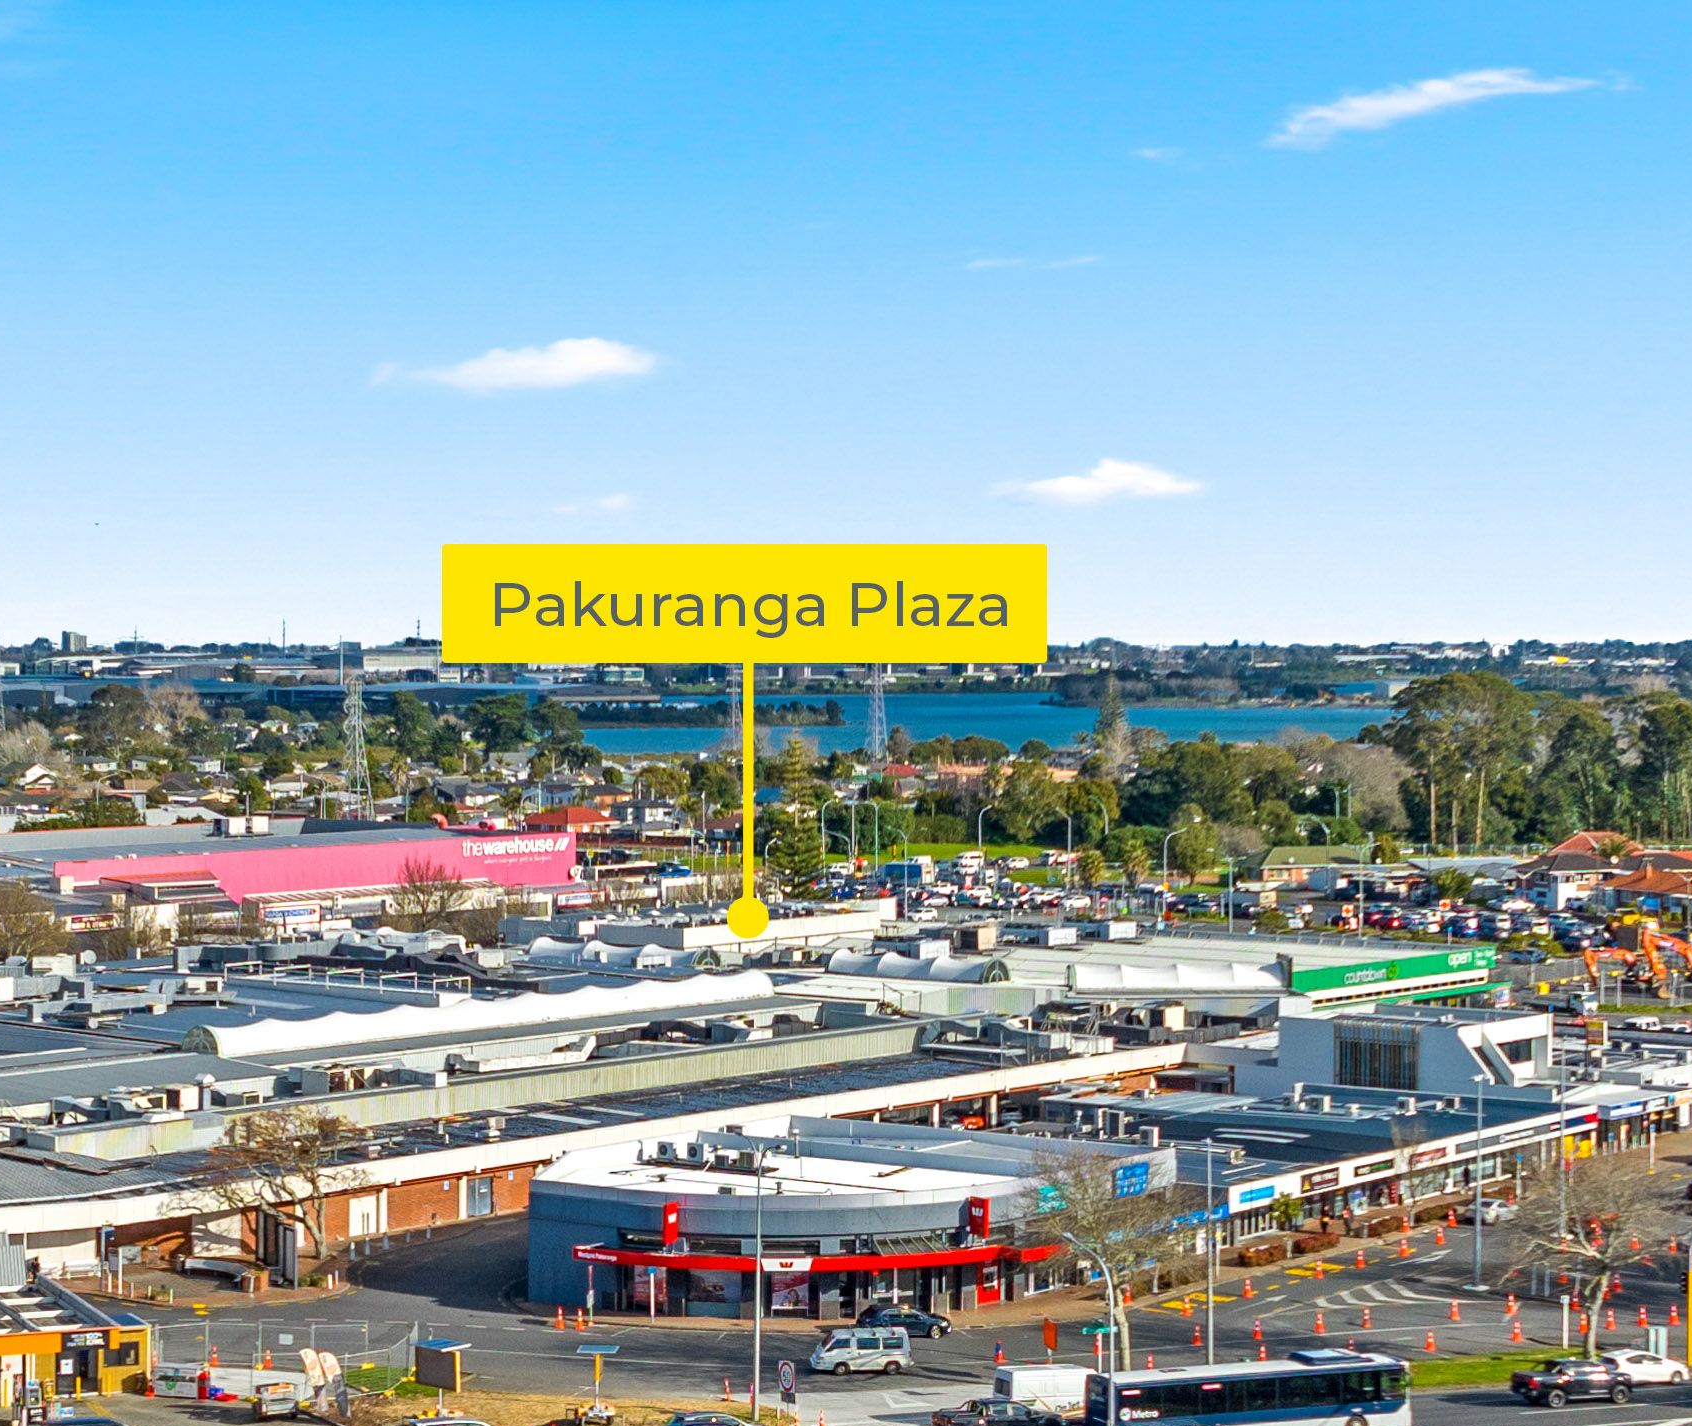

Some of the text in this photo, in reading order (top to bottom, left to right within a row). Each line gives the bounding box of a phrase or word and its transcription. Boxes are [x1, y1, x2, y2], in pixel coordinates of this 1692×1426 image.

[1448, 951, 1472, 969] open
[1344, 965, 1387, 985] countdown
[1132, 1409, 1159, 1419] Metro
